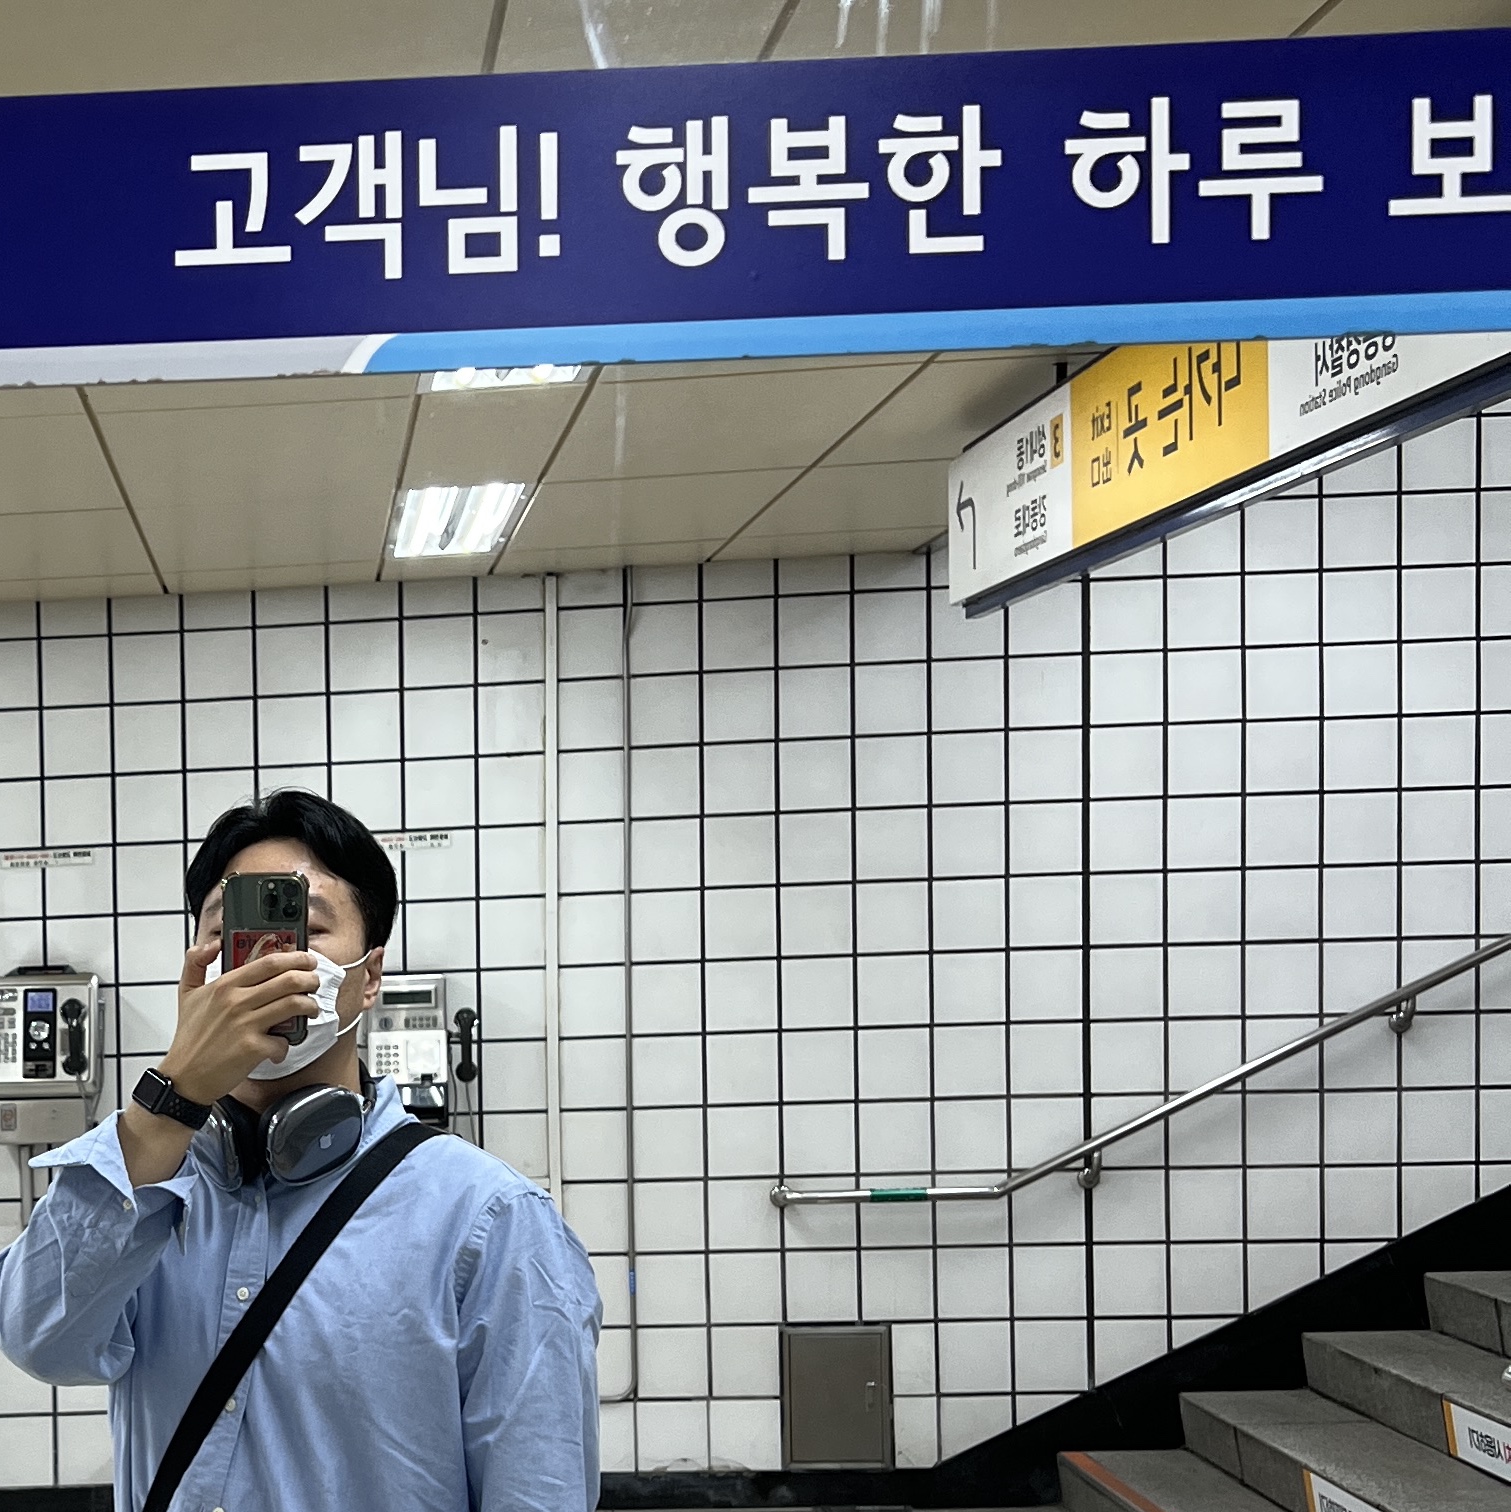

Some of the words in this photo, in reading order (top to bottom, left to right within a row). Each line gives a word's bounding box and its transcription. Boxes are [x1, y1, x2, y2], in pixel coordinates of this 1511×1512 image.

[175, 124, 561, 279] 고객님!
[615, 104, 1003, 268] 행복한
[1064, 96, 1324, 245] 하루
[1388, 94, 1511, 216] 보
